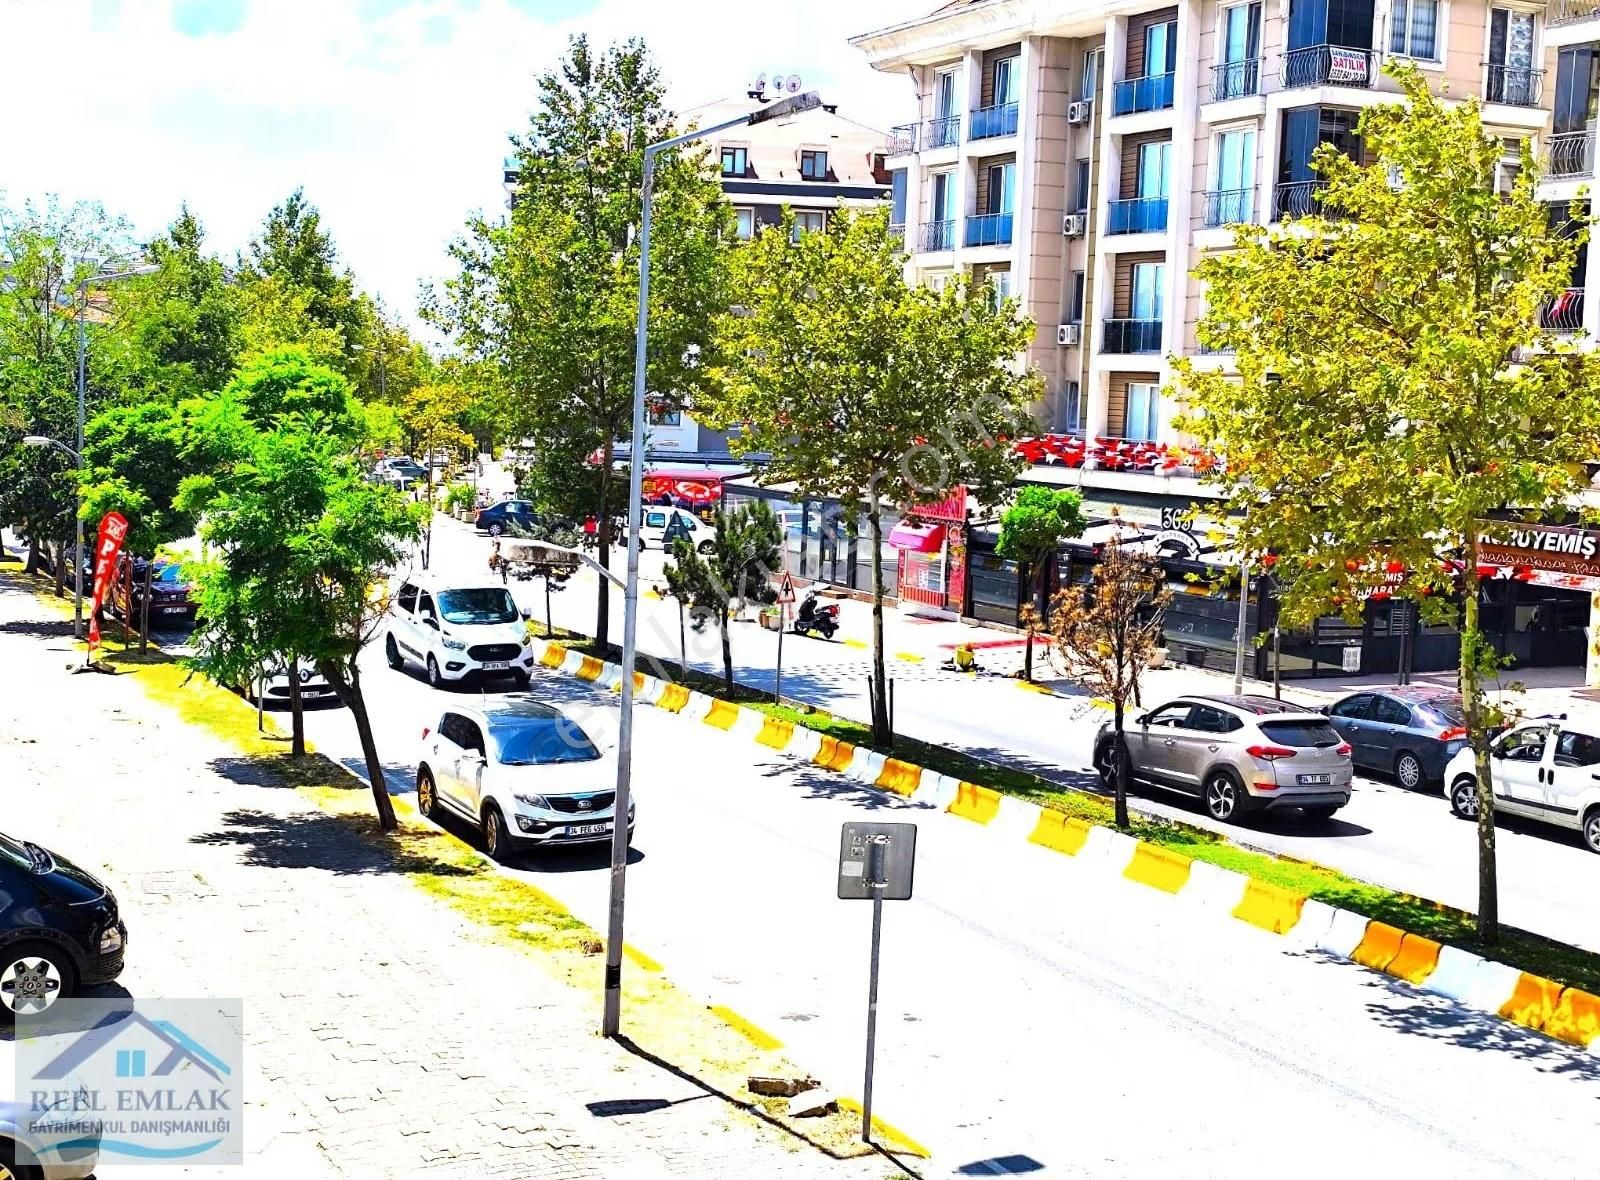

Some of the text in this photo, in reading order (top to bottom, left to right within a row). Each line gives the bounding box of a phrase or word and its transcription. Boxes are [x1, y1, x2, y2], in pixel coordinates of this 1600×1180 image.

[1333, 56, 1365, 72] SATILIK
[1478, 528, 1596, 560] KRUYEMİŞ
[580, 826, 592, 834] FEG
[593, 824, 606, 832] 455
